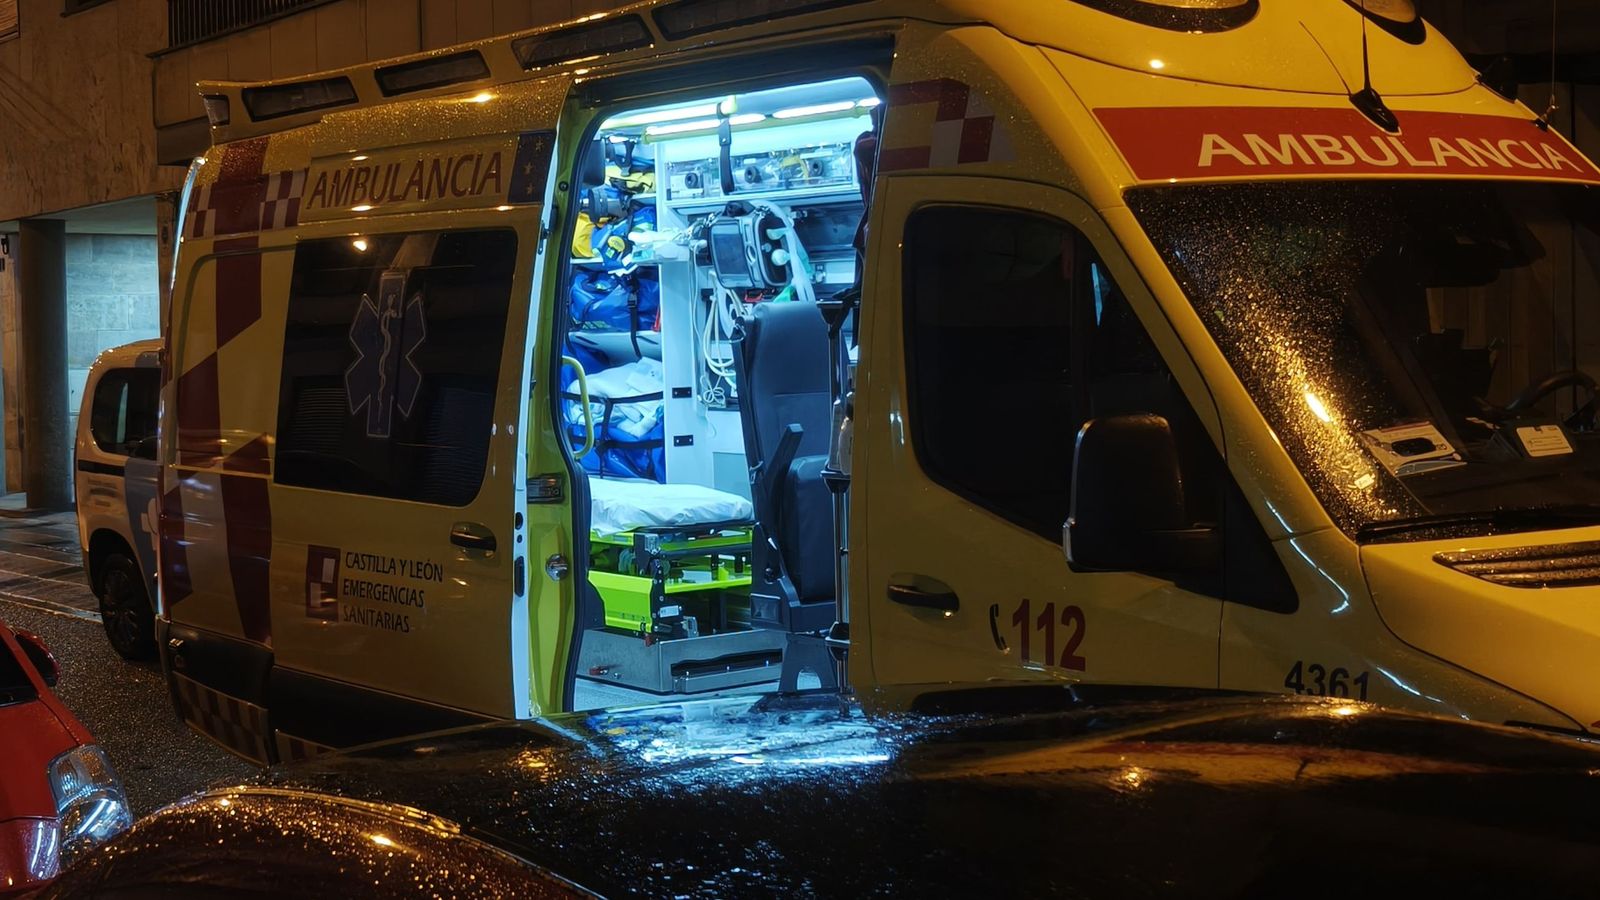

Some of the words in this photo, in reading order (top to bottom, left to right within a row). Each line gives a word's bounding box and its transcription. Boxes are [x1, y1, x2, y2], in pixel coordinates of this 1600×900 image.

[1197, 133, 1584, 173] AMBULANCIA
[305, 151, 502, 210] AMBULANCIA
[345, 552, 397, 576] CASTILLA
[398, 559, 408, 577] Y
[409, 558, 443, 583] LEÓN
[343, 578, 425, 608] EMERGENCIAS
[343, 605, 410, 633] SANITARIAS
[1012, 598, 1086, 672] 112
[1284, 660, 1369, 701] 4361
